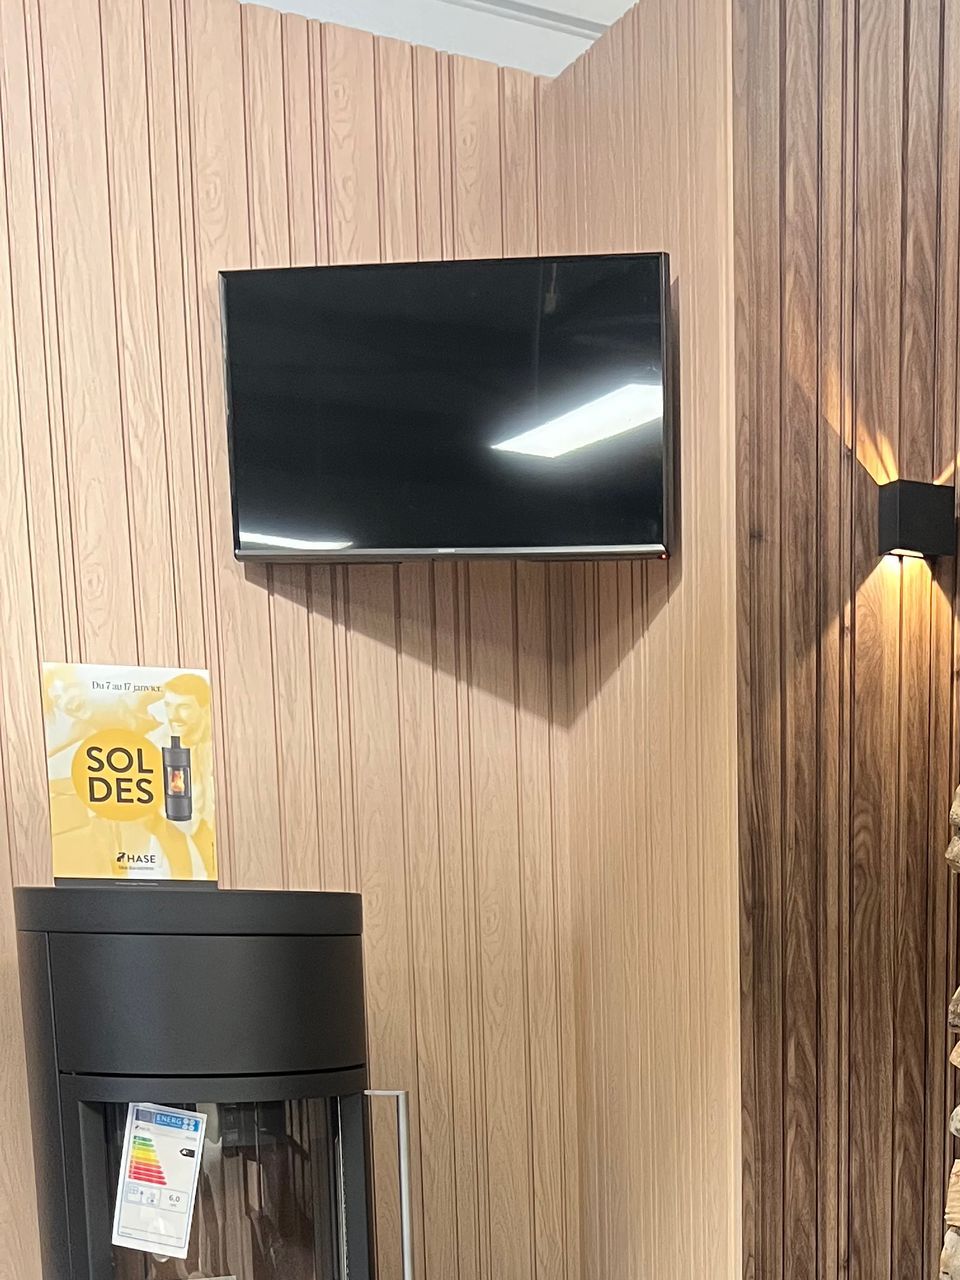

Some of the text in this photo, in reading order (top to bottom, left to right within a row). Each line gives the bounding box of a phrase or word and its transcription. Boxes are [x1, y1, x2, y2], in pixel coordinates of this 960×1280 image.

[91, 680, 105, 690] Du
[105, 681, 111, 690] 7
[86, 746, 154, 774] SOL
[88, 776, 154, 804] DES
[127, 854, 156, 864] HASE
[156, 1114, 182, 1125] ENERG
